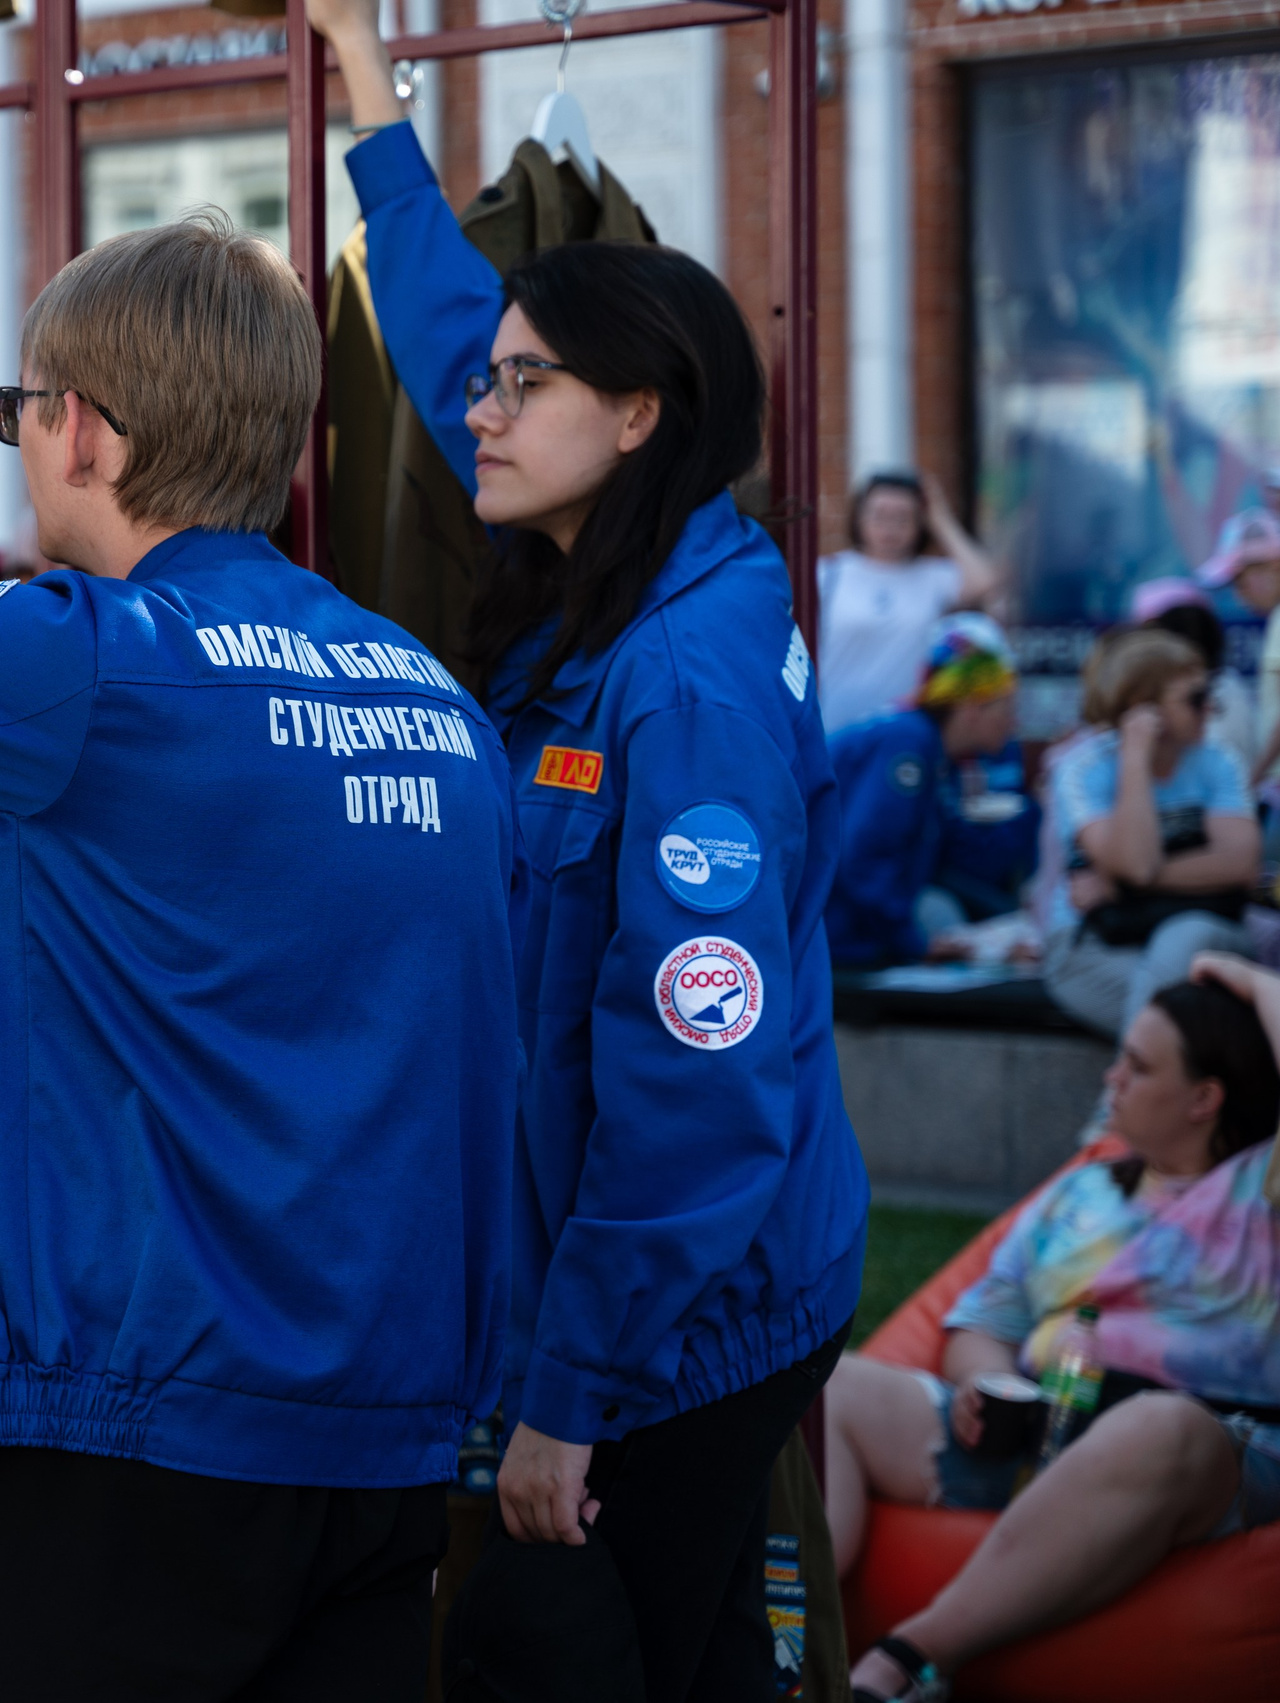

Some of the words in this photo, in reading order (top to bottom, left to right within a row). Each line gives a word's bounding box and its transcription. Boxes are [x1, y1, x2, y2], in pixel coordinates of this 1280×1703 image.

[269, 696, 477, 761] СТУДЕНЧЕСКИЙ
[344, 775, 441, 833] ОТРЯД
[666, 848, 698, 861] ТРУД
[671, 860, 705, 872] КРУТ
[680, 970, 738, 989] ООСО
